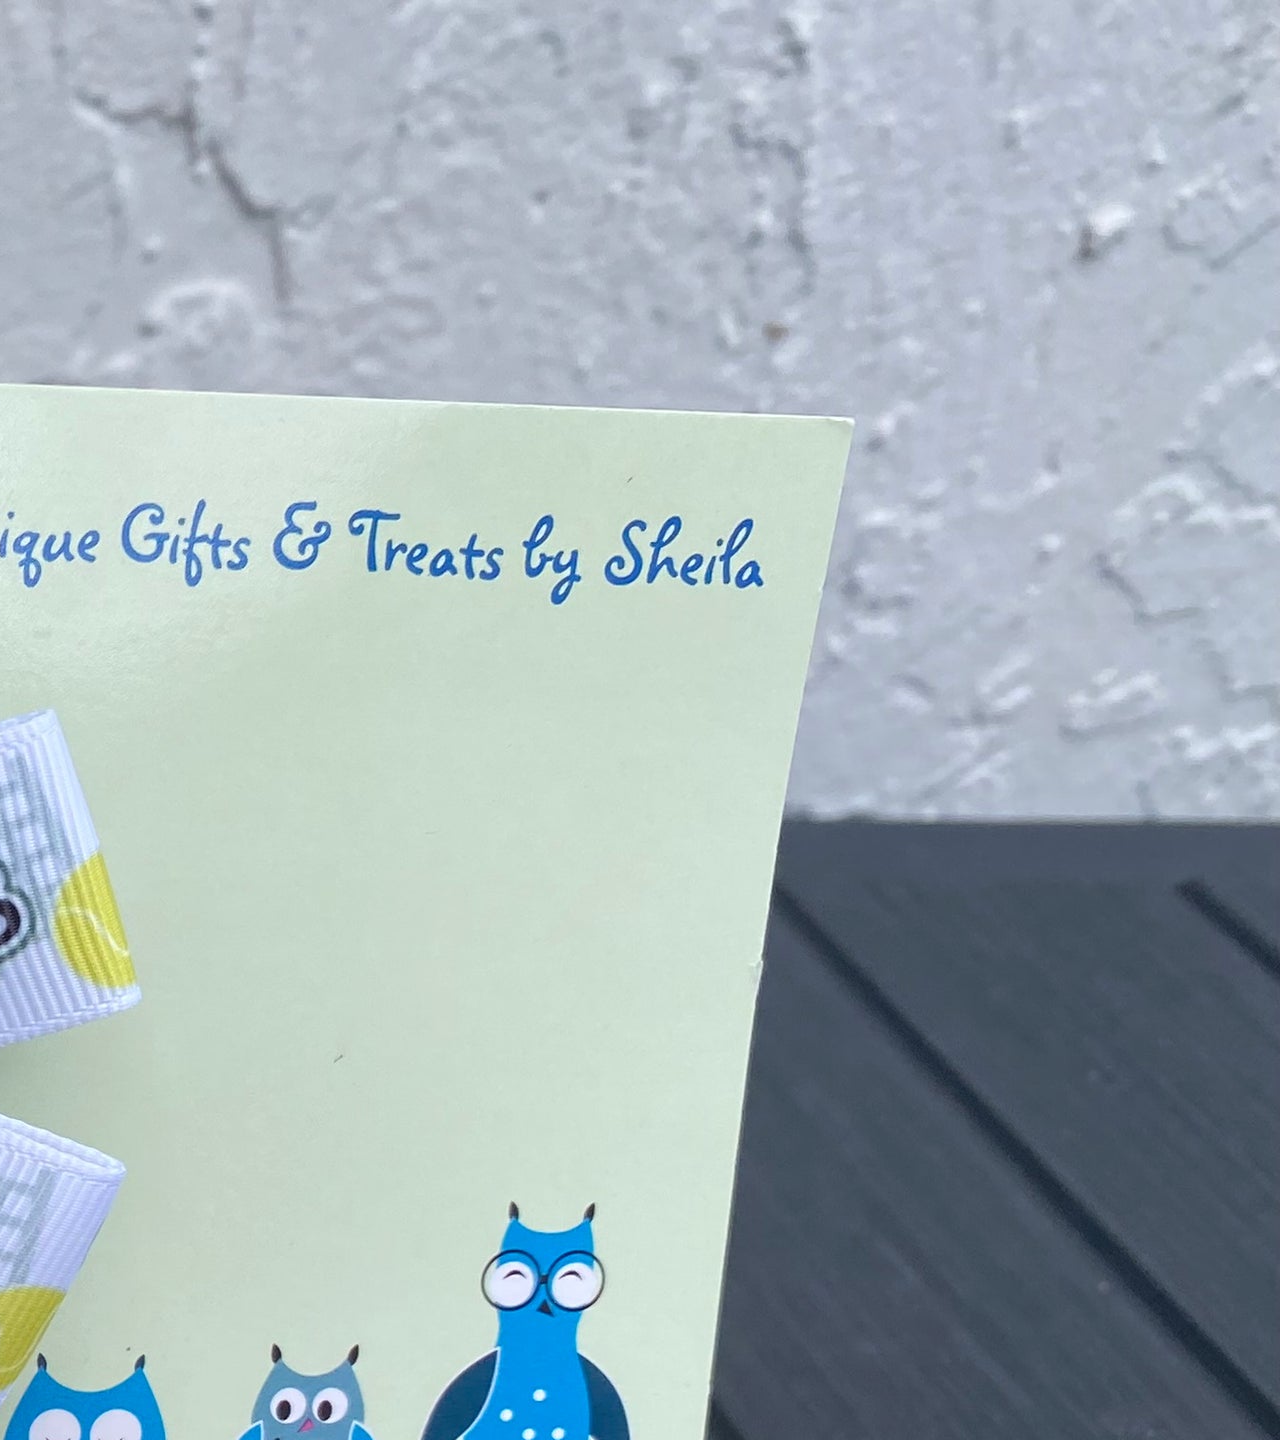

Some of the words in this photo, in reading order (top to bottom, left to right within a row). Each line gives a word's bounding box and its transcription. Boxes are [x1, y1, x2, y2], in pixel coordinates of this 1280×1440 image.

[121, 498, 249, 587] Gifts
[272, 502, 330, 570] &
[348, 508, 504, 580] Treats
[523, 514, 580, 605] by
[604, 517, 763, 589] Sheila
